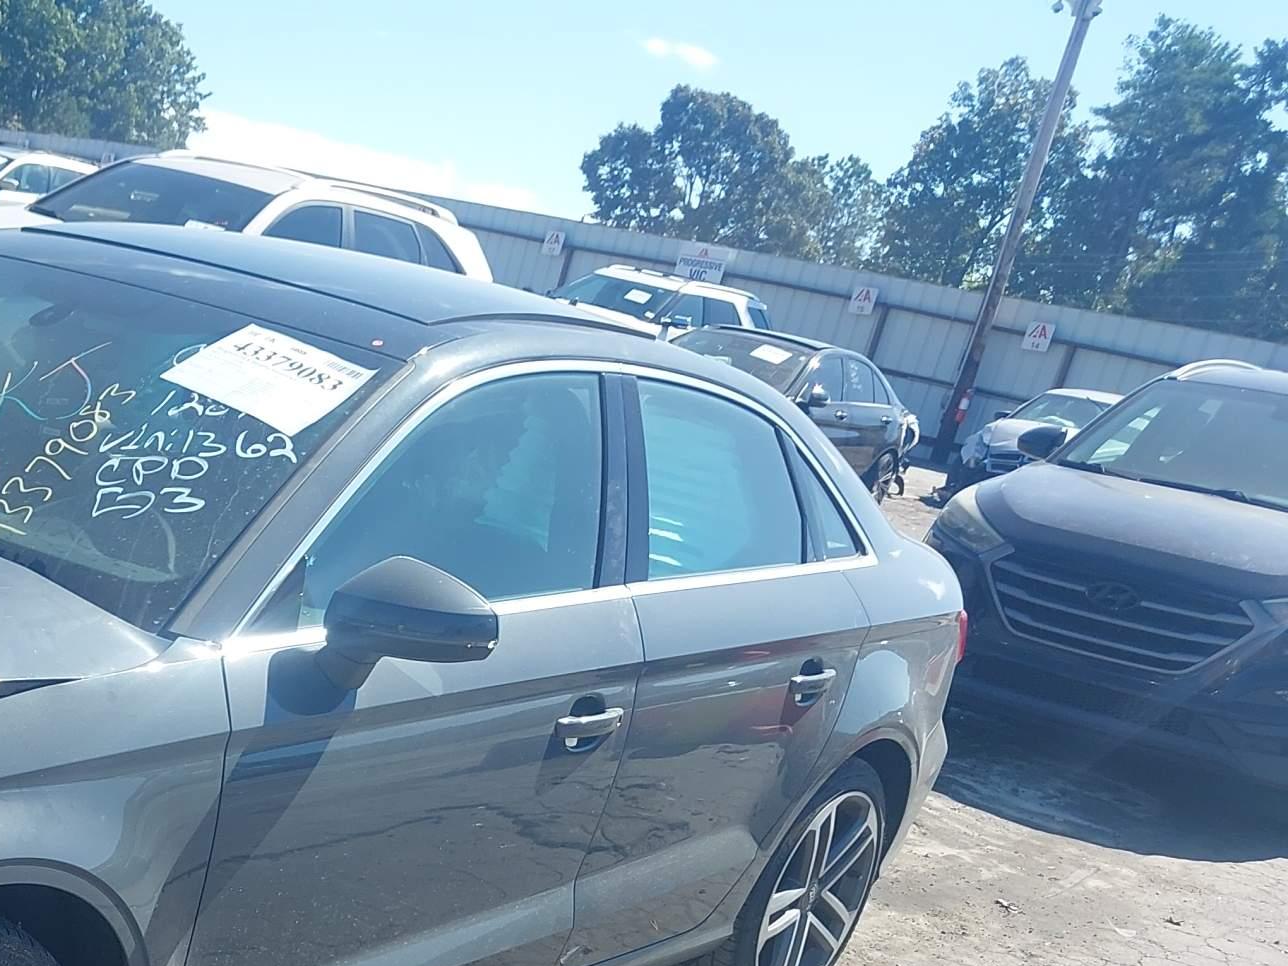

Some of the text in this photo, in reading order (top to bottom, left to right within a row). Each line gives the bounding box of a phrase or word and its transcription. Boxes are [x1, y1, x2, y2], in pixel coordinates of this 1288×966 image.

[678, 256, 723, 272] PROGRESSIVE
[689, 268, 708, 281] VIC
[232, 341, 344, 392] 43379083
